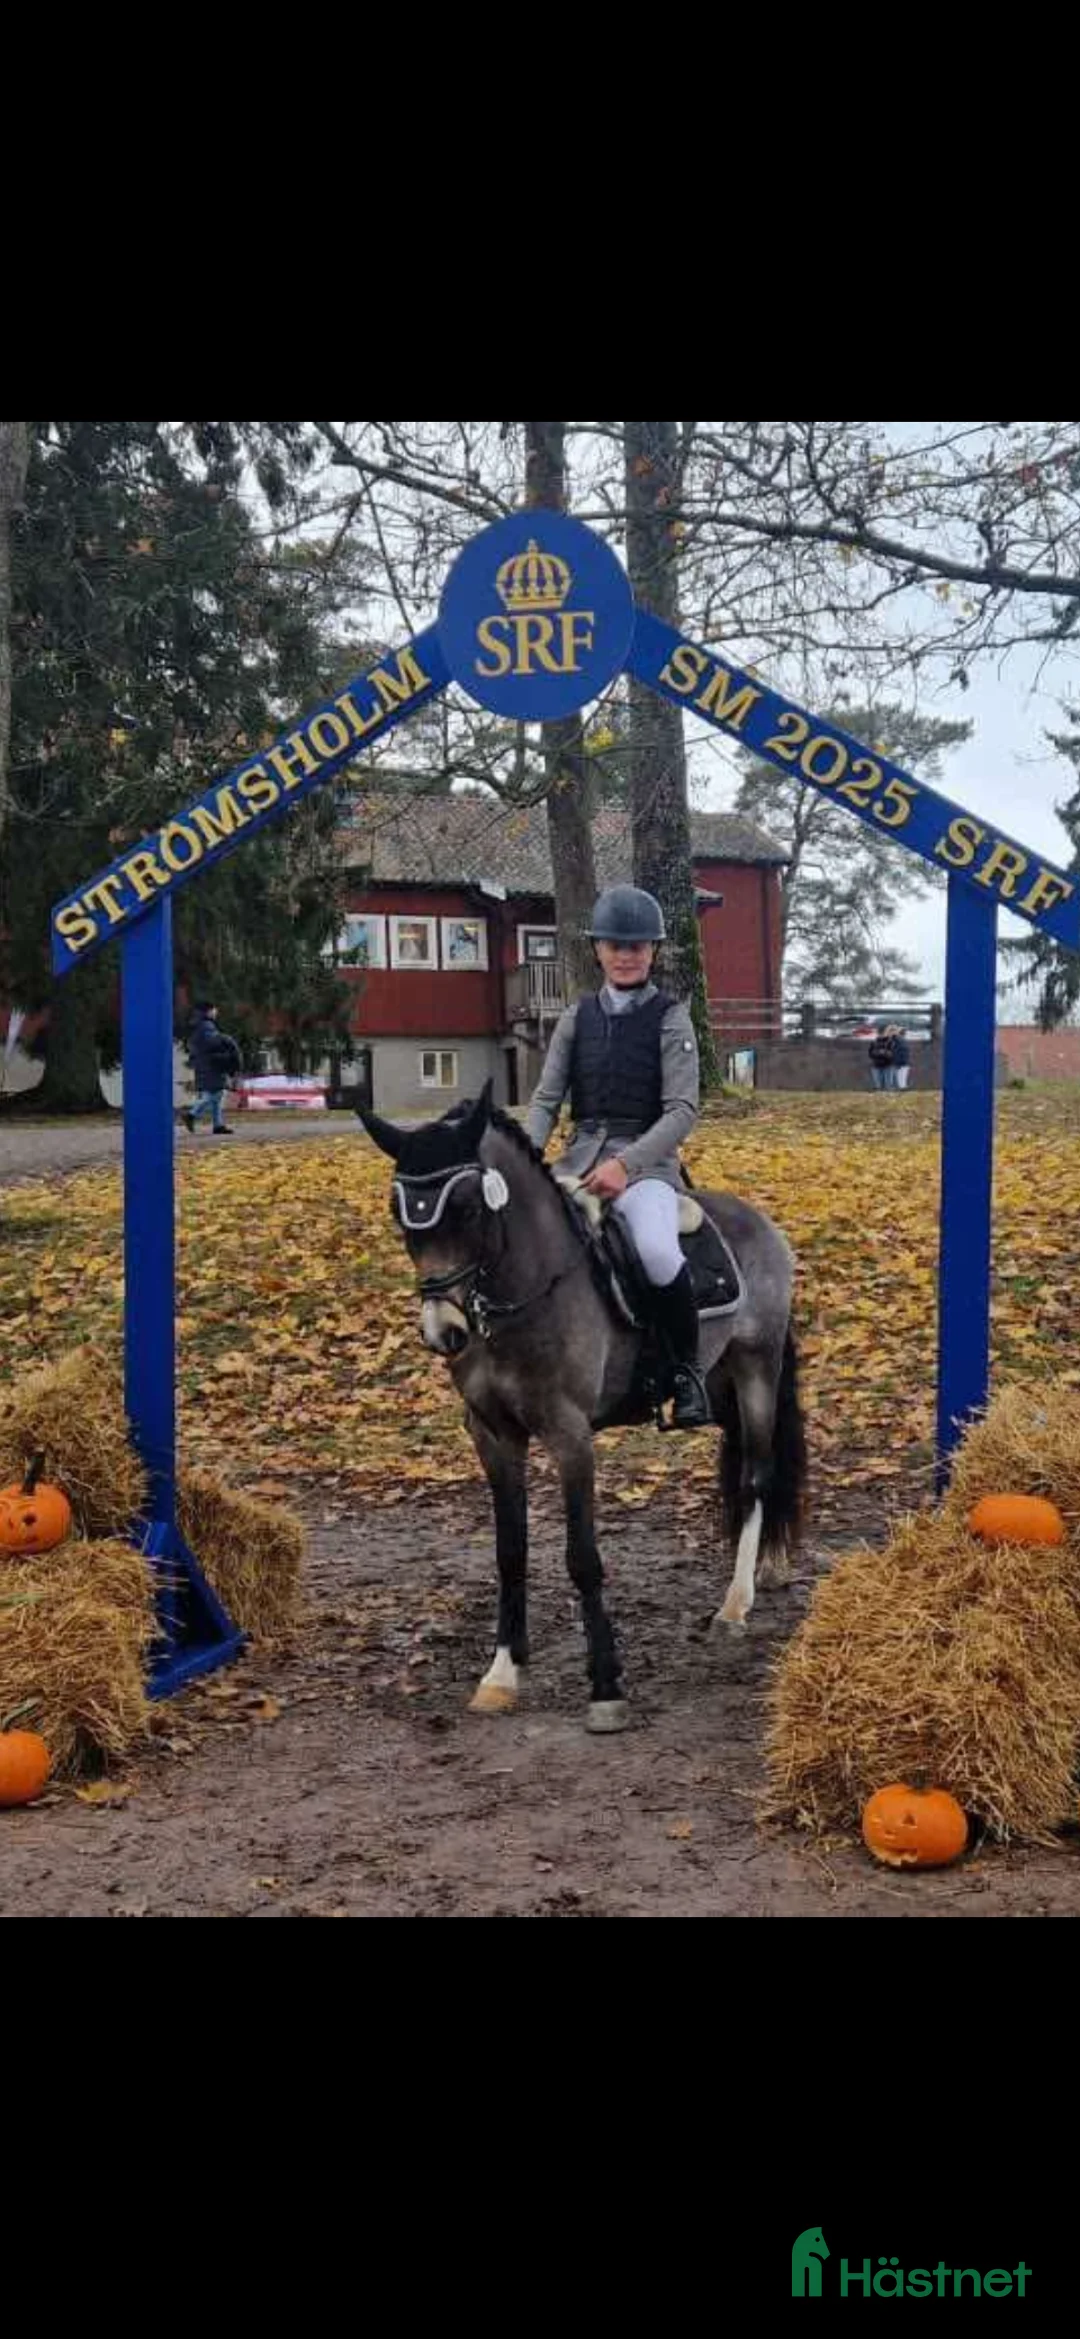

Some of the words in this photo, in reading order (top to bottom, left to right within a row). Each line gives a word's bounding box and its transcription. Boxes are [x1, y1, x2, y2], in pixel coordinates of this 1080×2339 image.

[475, 611, 595, 677] SRF
[54, 649, 432, 952] STRÖMSHOLM
[659, 645, 761, 731] SM
[764, 712, 920, 826] 2025
[934, 817, 1072, 916] SRF
